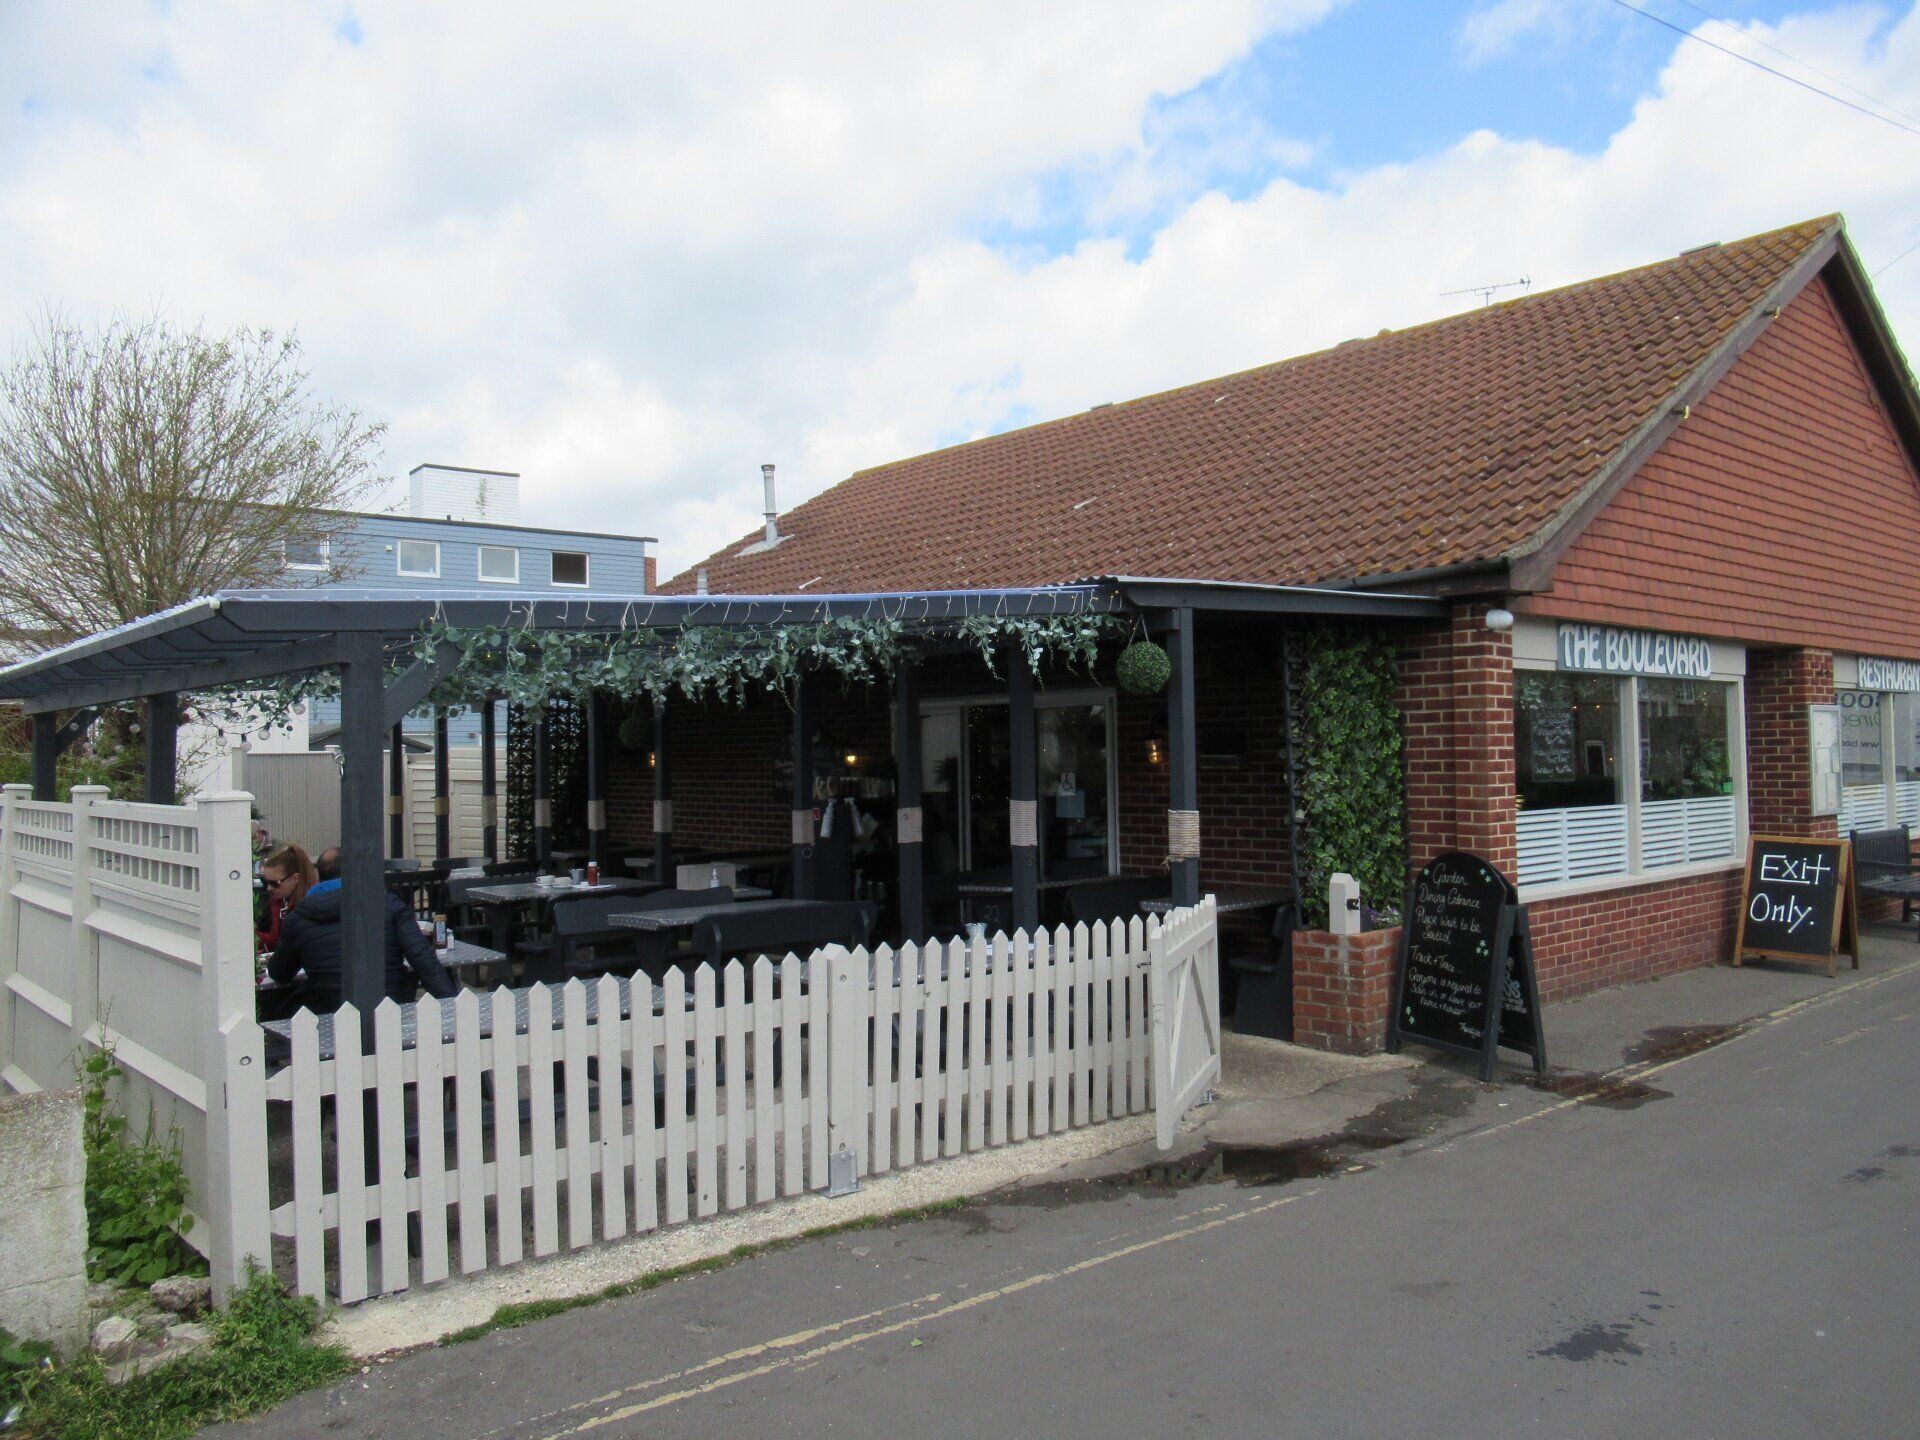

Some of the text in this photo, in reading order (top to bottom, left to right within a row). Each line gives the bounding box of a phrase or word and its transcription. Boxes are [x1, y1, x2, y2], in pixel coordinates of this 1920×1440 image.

[1559, 623, 1712, 677] THE BOULEVARD
[1432, 862, 1470, 887] Garden
[1761, 854, 1831, 885] Exit
[1418, 882, 1481, 912] Dining Entrance
[1415, 905, 1438, 925] Please
[1460, 917, 1468, 931] to
[1470, 917, 1482, 933] be
[1410, 945, 1432, 966] Track
[1438, 954, 1456, 973] Trace
[1408, 966, 1482, 995] Everyone is required to
